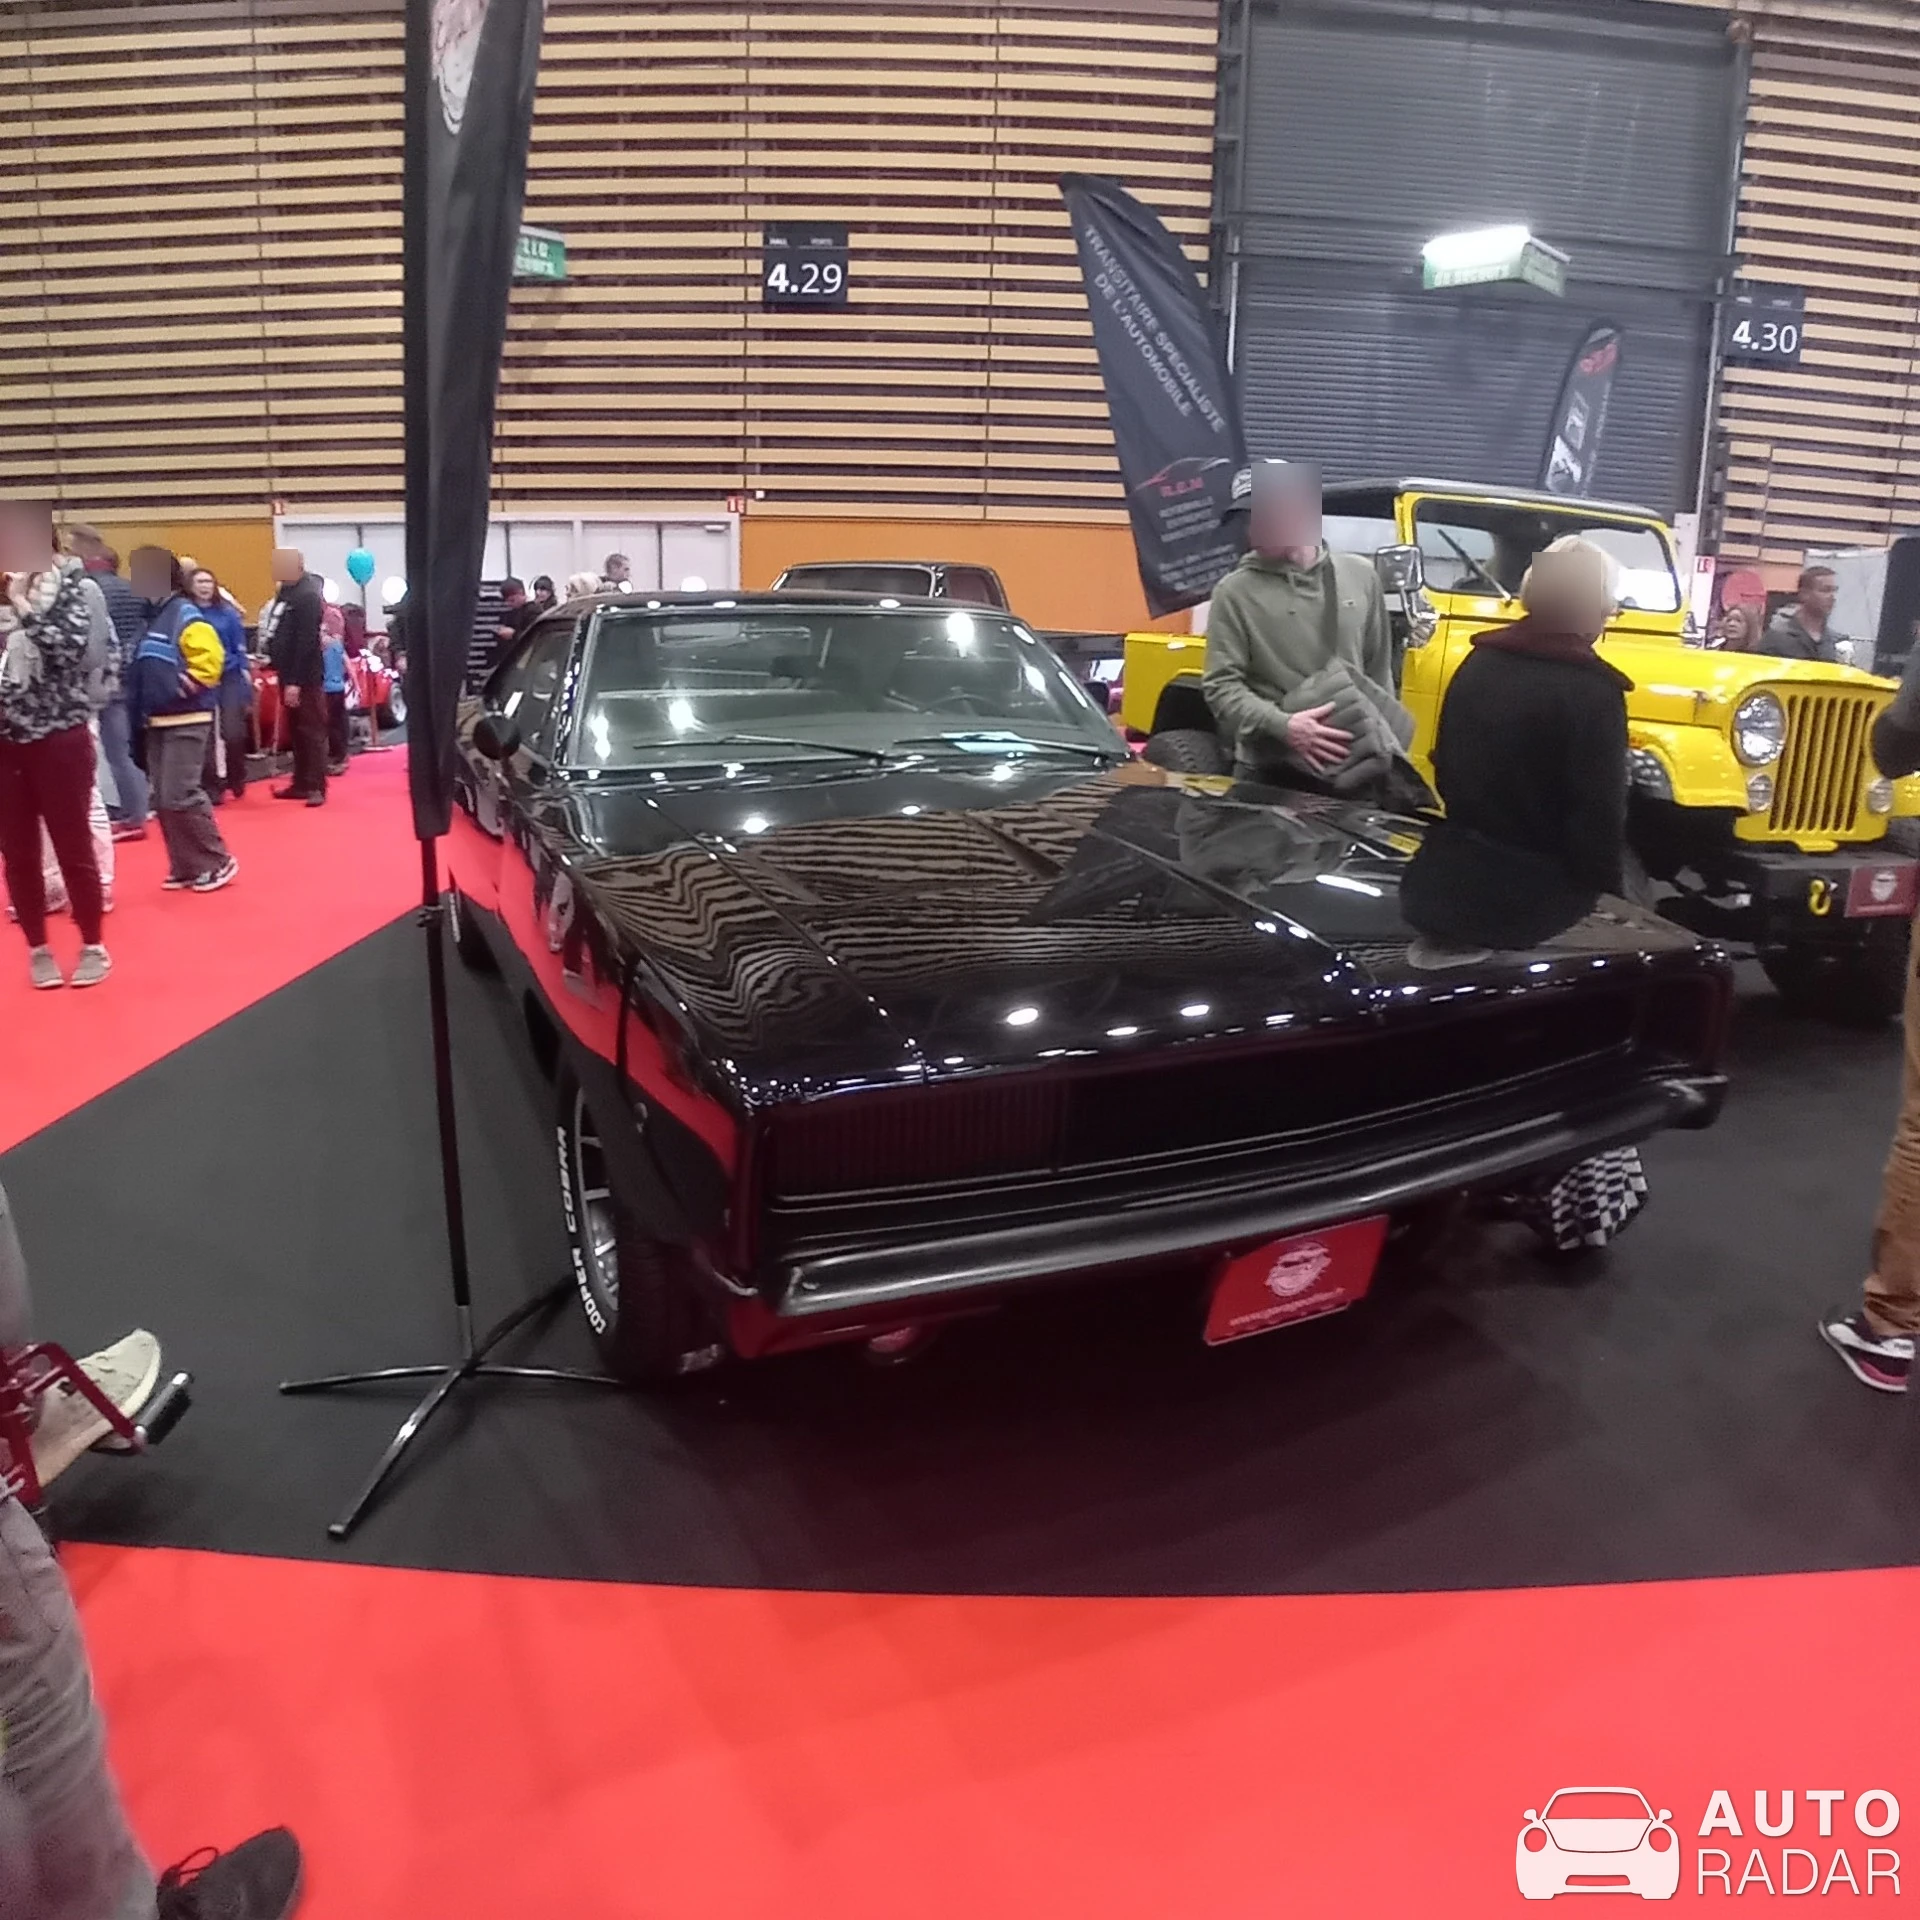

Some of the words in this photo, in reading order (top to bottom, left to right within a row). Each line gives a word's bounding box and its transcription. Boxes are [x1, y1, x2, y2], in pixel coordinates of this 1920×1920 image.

[767, 263, 842, 294] 4.29
[1085, 224, 1160, 331] TRANSITAIRE
[1154, 331, 1225, 433] SPECIALISTE
[1094, 273, 1116, 300] DE
[1112, 299, 1194, 417] L'AUTOMOBILE
[1732, 320, 1798, 354] 4.30
[556, 1125, 578, 1234] COBRA
[572, 1247, 607, 1335] COOPER
